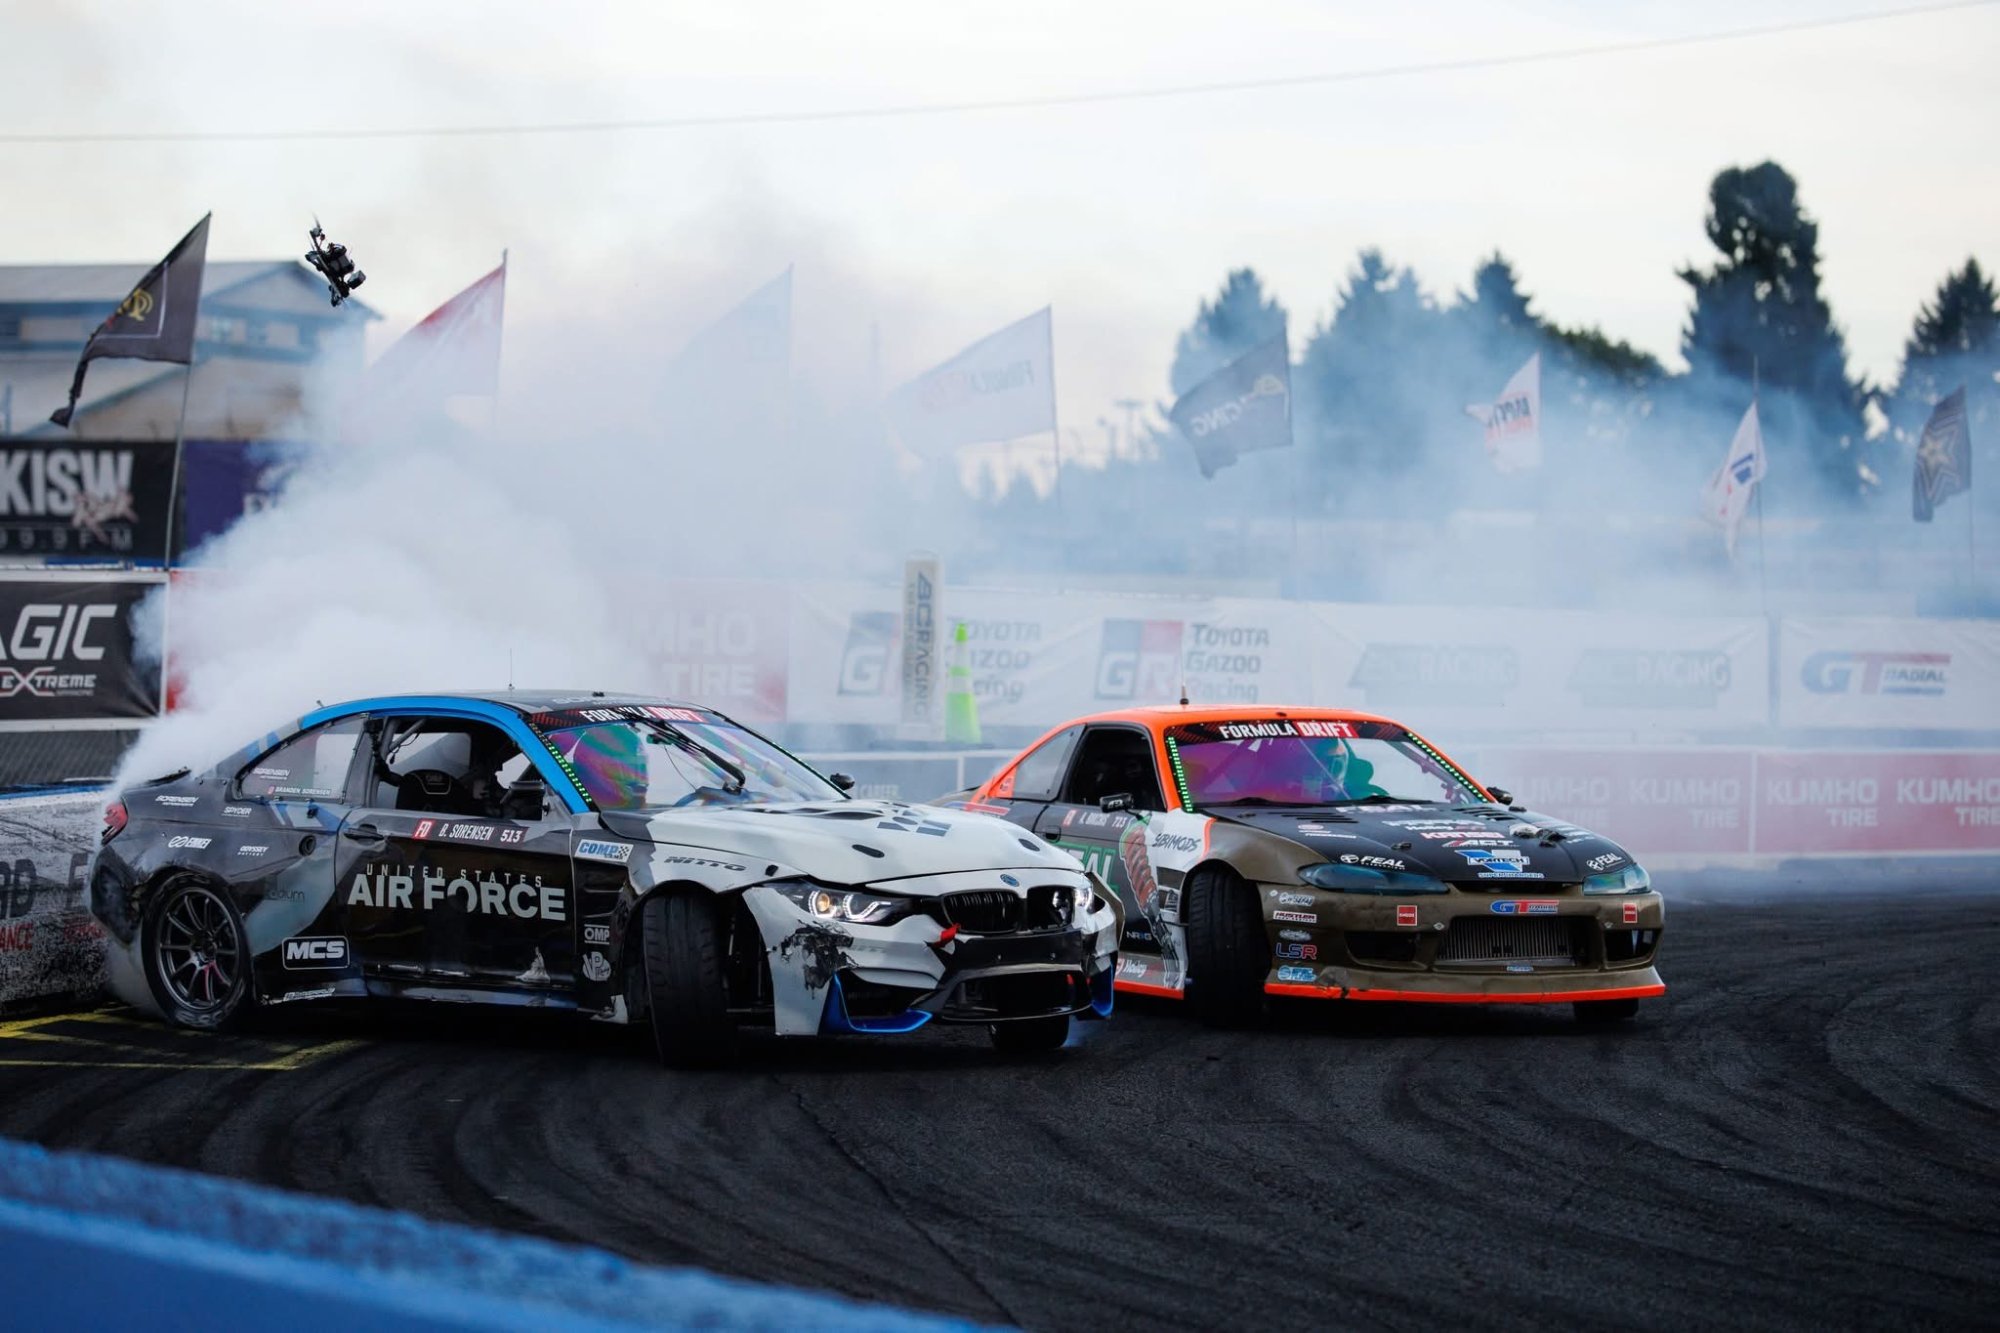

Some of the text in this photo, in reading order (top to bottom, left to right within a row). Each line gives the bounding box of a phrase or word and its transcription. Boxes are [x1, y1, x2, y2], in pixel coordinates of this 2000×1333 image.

[0, 604, 118, 661] GIC
[1191, 622, 1269, 646] TOYOTA
[1185, 651, 1261, 674] GAZOO
[1219, 721, 1353, 739] FORMULA DRIFT
[1629, 778, 1741, 804] KUMHO
[1767, 778, 1879, 804] KUMHO
[1689, 809, 1739, 829] TIRE
[1825, 807, 1879, 828] TIRE
[438, 823, 447, 837] B.
[449, 824, 495, 840] SORENSEN
[500, 829, 522, 843] 513
[579, 842, 619, 855] COMP
[1360, 856, 1405, 868] FEAL
[1594, 853, 1623, 866] FEAL
[366, 863, 542, 888] UNITED STATES
[347, 874, 567, 921] AIR FORCE
[584, 927, 610, 942] OMP
[287, 940, 346, 960] MCS
[1275, 943, 1317, 960] LSR
